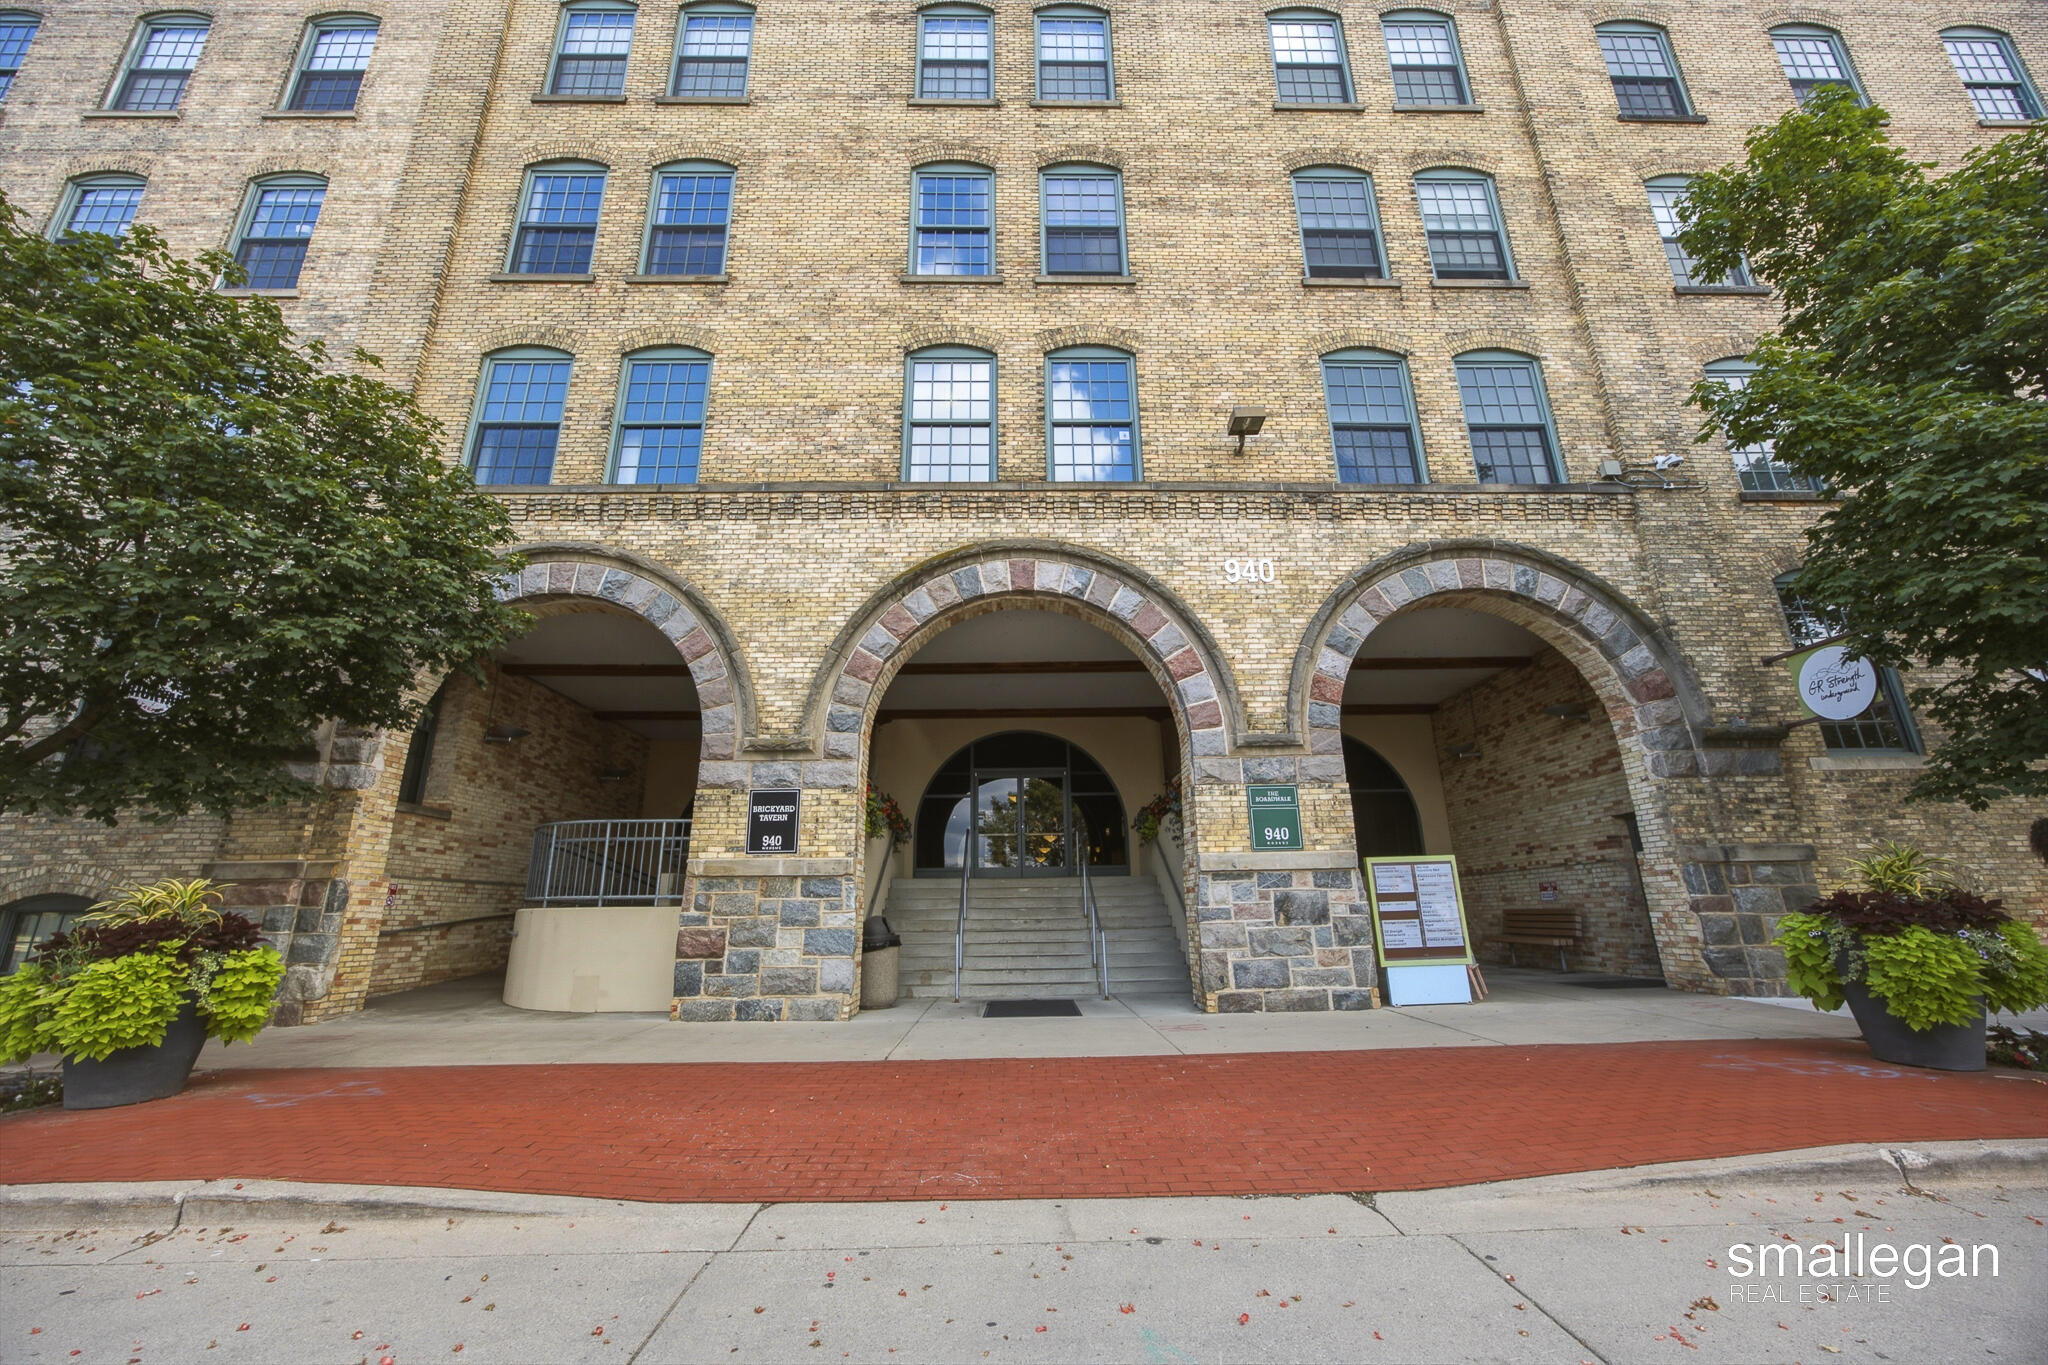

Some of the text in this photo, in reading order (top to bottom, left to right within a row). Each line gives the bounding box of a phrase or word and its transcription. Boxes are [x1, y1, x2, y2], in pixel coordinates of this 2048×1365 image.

[1224, 558, 1275, 583] 940
[1808, 667, 1866, 696] GR Strength
[1821, 683, 1860, 703] underground
[752, 805, 796, 813] BRICKYARD
[759, 814, 788, 822] TAVERN
[762, 834, 782, 847] 940
[1264, 827, 1289, 841] 940
